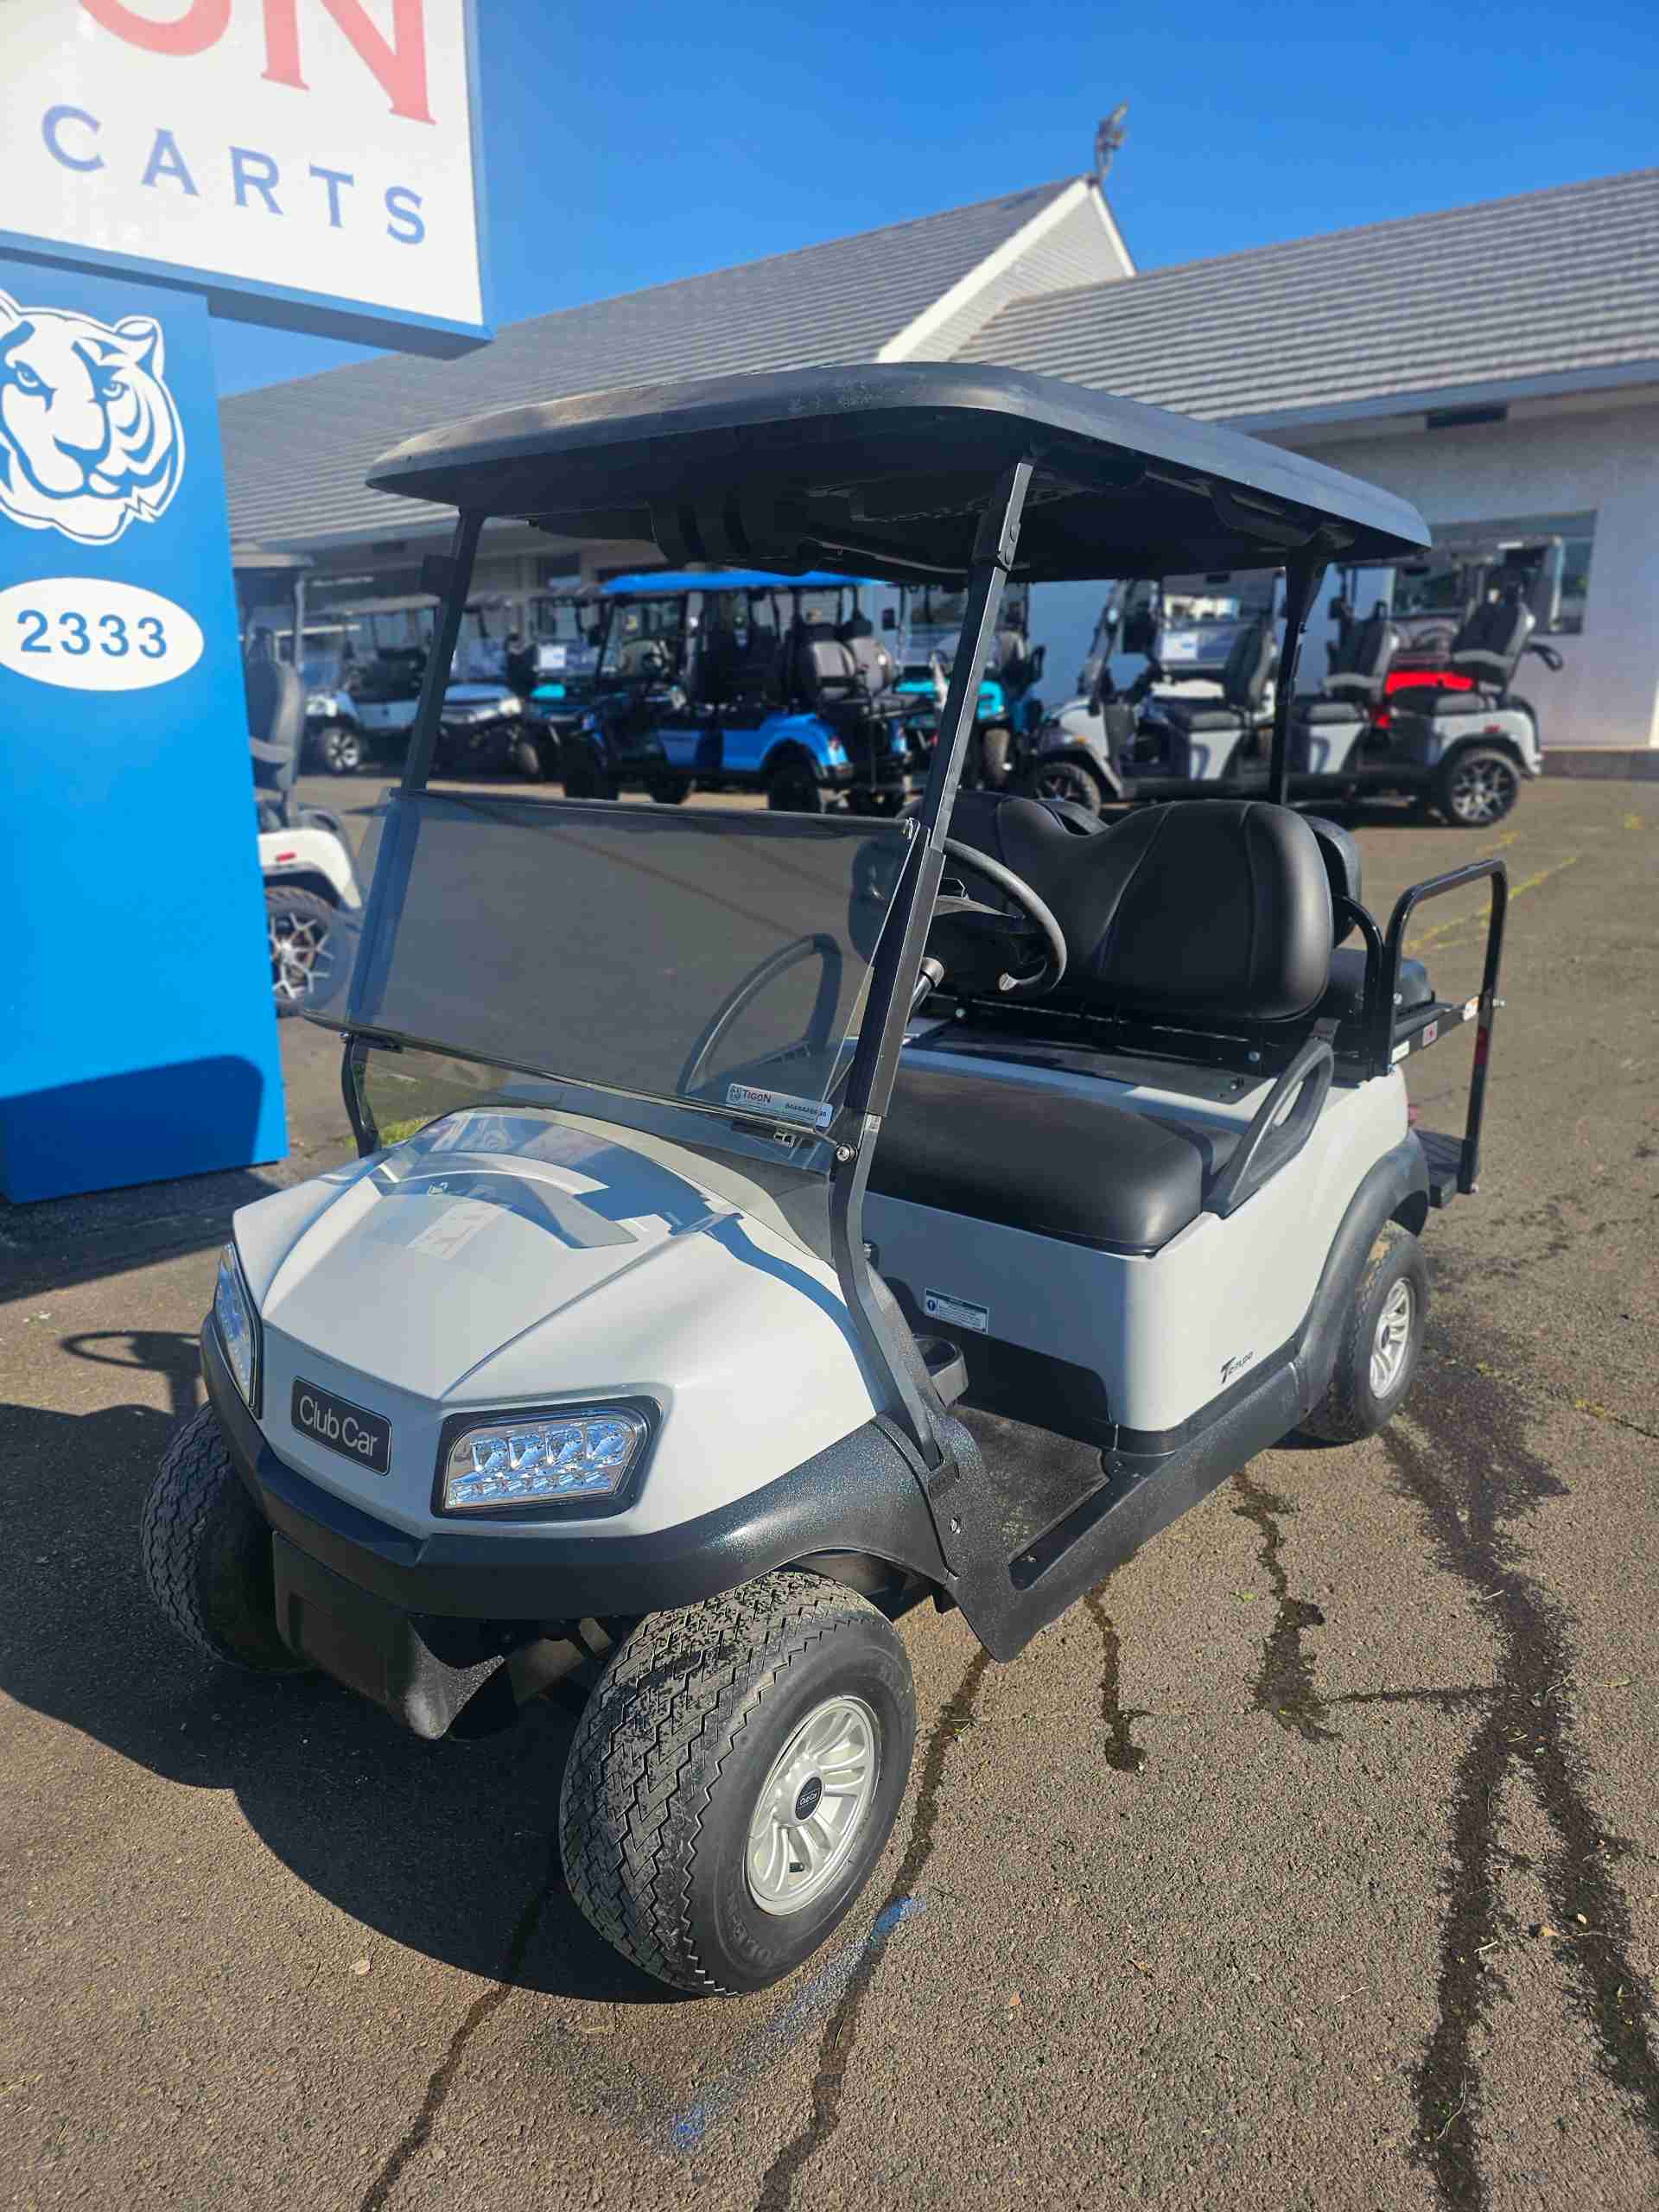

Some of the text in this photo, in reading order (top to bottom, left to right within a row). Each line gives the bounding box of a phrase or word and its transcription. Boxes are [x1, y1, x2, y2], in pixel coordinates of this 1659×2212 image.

[41, 104, 427, 245] CARTS
[16, 609, 168, 658] 2333
[299, 1395, 378, 1457] Club Car
